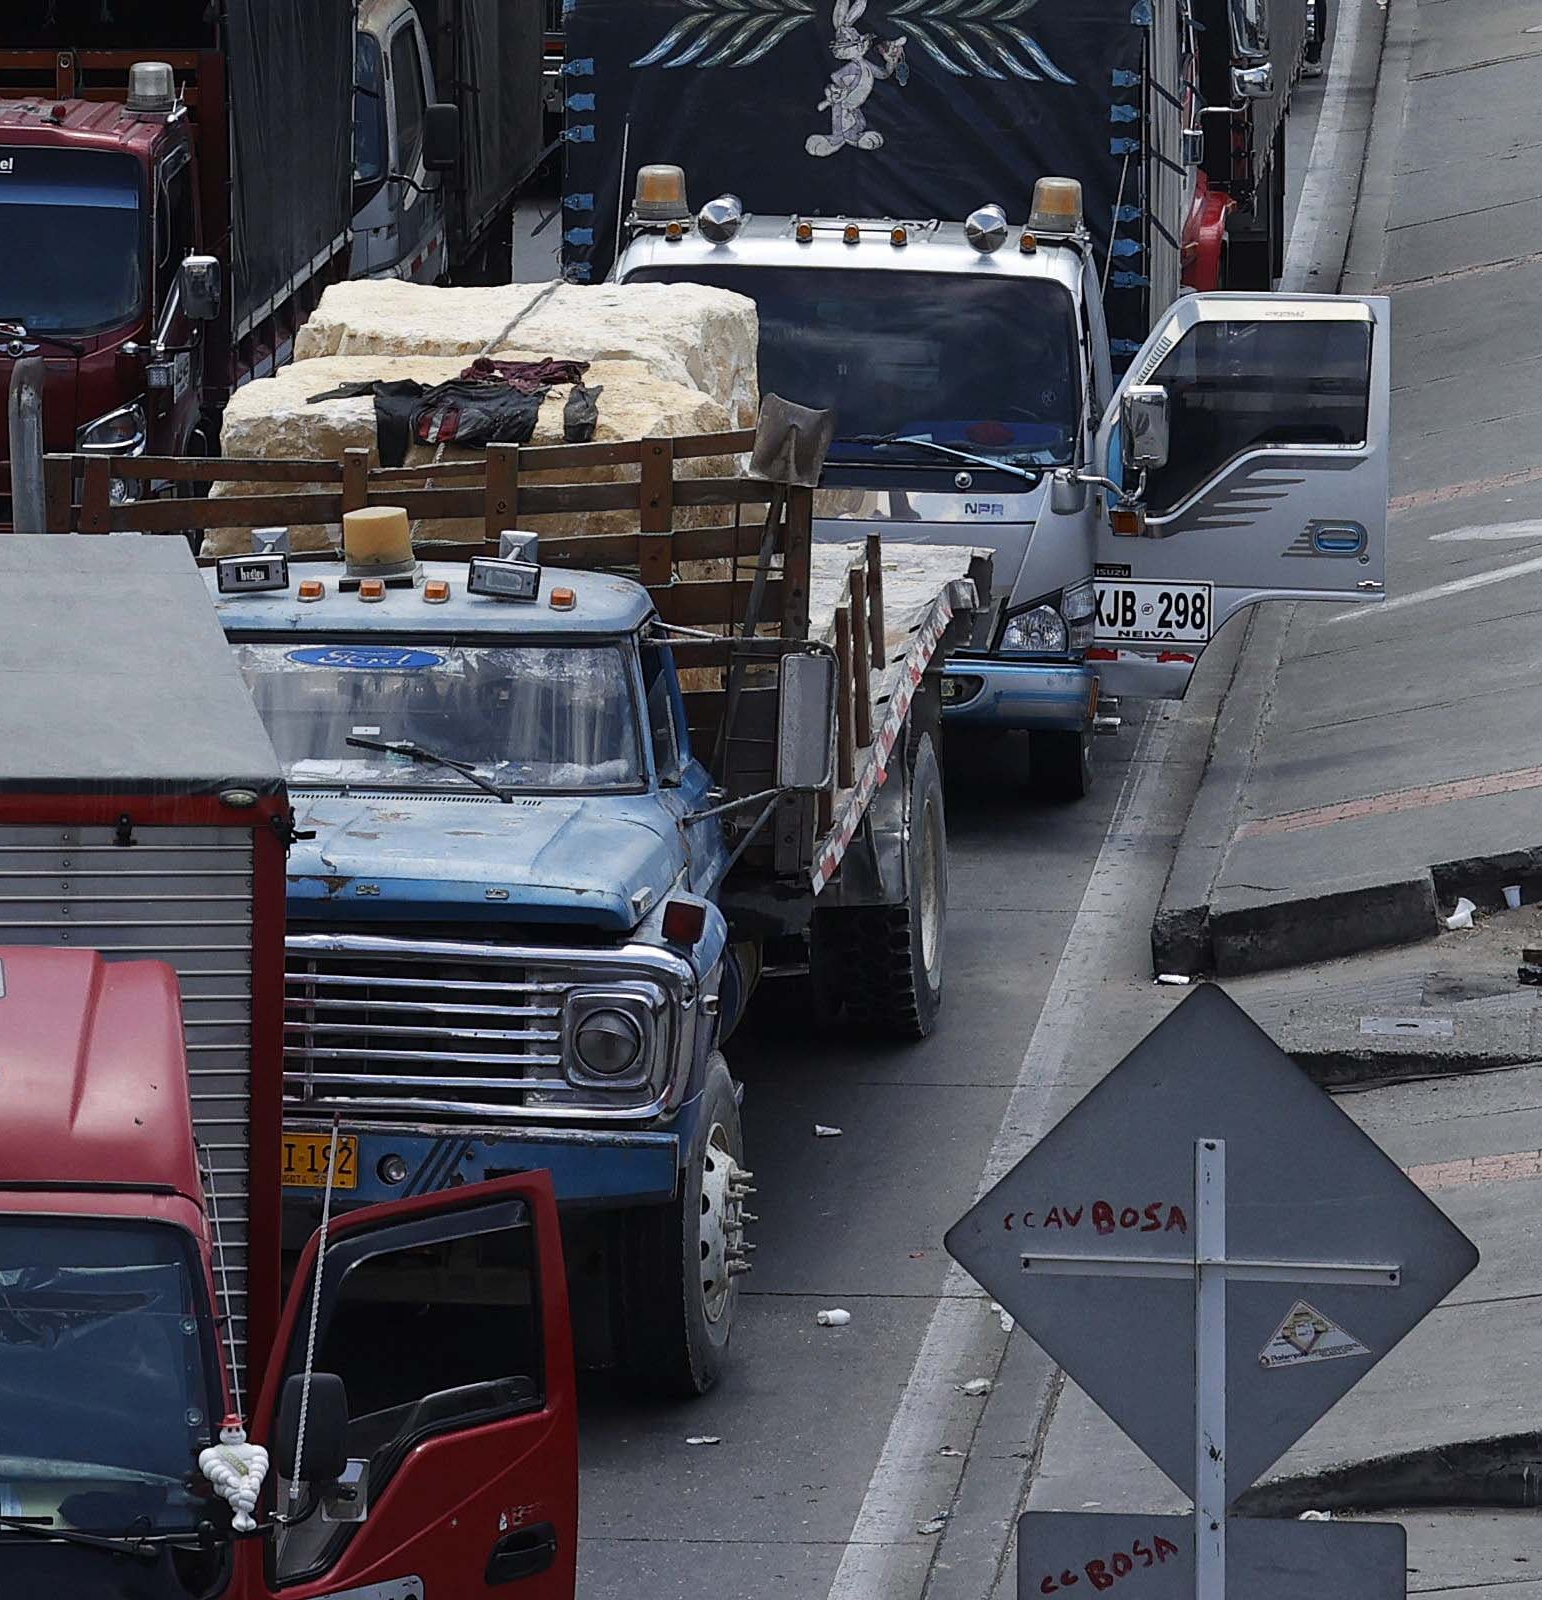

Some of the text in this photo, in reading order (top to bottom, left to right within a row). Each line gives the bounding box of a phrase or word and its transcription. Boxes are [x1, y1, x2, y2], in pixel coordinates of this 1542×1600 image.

[963, 502, 1004, 515] NPR
[1095, 568, 1129, 578] ISUZU
[1158, 591, 1207, 630] 298
[1117, 629, 1176, 640] NEIVA
[318, 649, 412, 667] Ford
[1091, 1200, 1189, 1237] BOSA
[1084, 1535, 1179, 1591] BOSA
